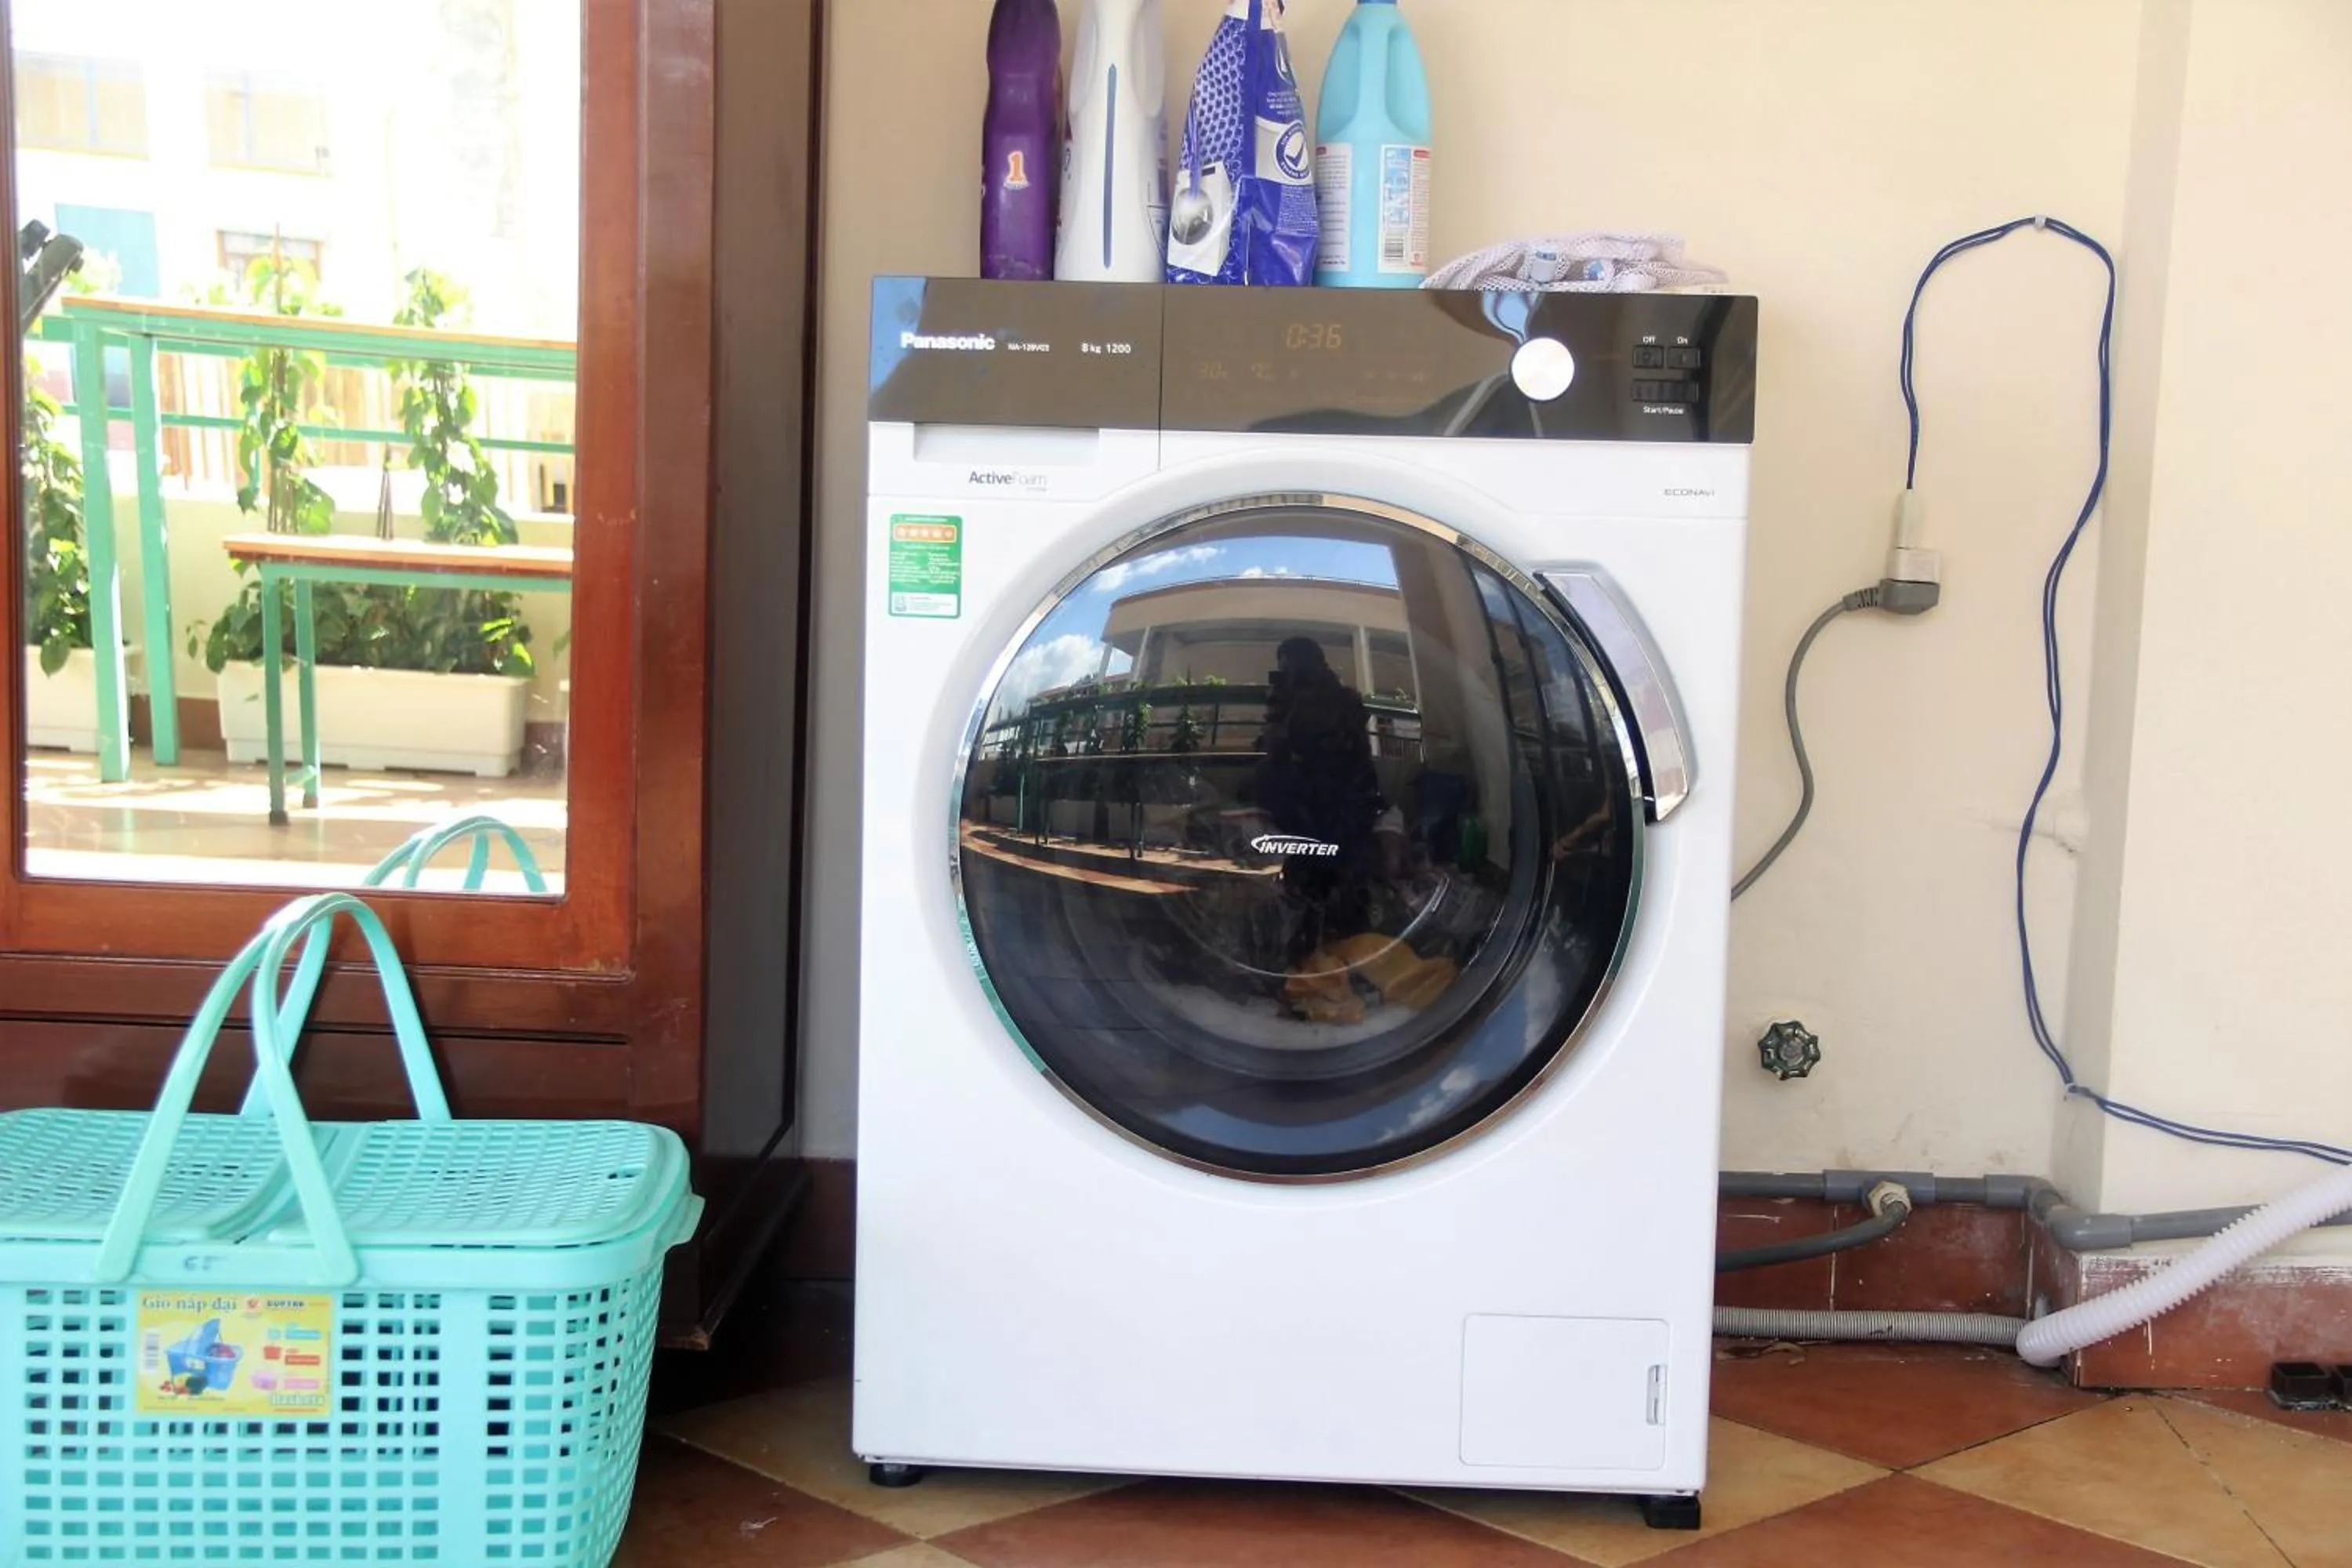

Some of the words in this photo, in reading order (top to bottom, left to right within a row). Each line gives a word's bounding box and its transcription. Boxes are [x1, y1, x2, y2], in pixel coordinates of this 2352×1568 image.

[901, 332, 996, 350] Panasonic
[1287, 323, 1341, 350] 0:36
[1106, 343, 1131, 354] 1200
[1257, 839, 1339, 856] INVERTER
